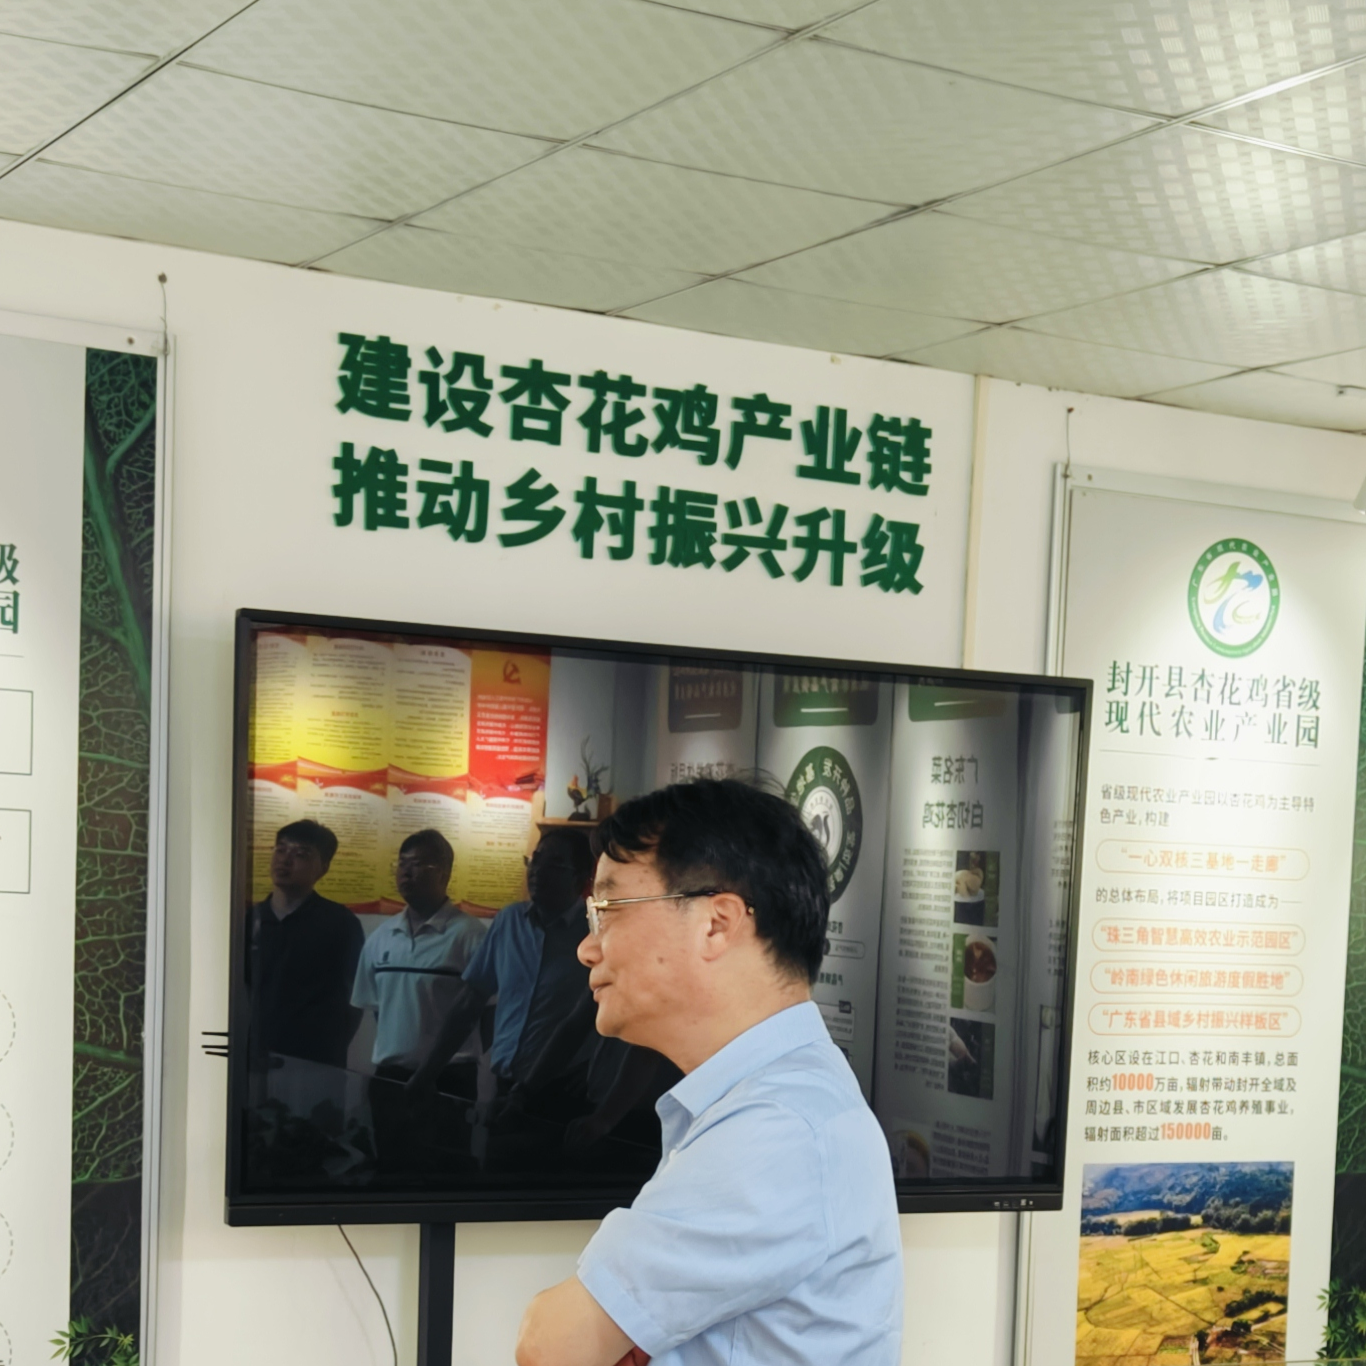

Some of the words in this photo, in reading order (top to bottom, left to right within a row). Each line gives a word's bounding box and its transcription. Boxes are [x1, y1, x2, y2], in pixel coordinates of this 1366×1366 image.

[335, 331, 933, 497] 建设杏花鸡产业链
[331, 441, 925, 596] 推动乡村振兴升级
[1104, 699, 1320, 750] 现代农业产业园
[1106, 660, 1321, 712] 封开县杏花鸡省级
